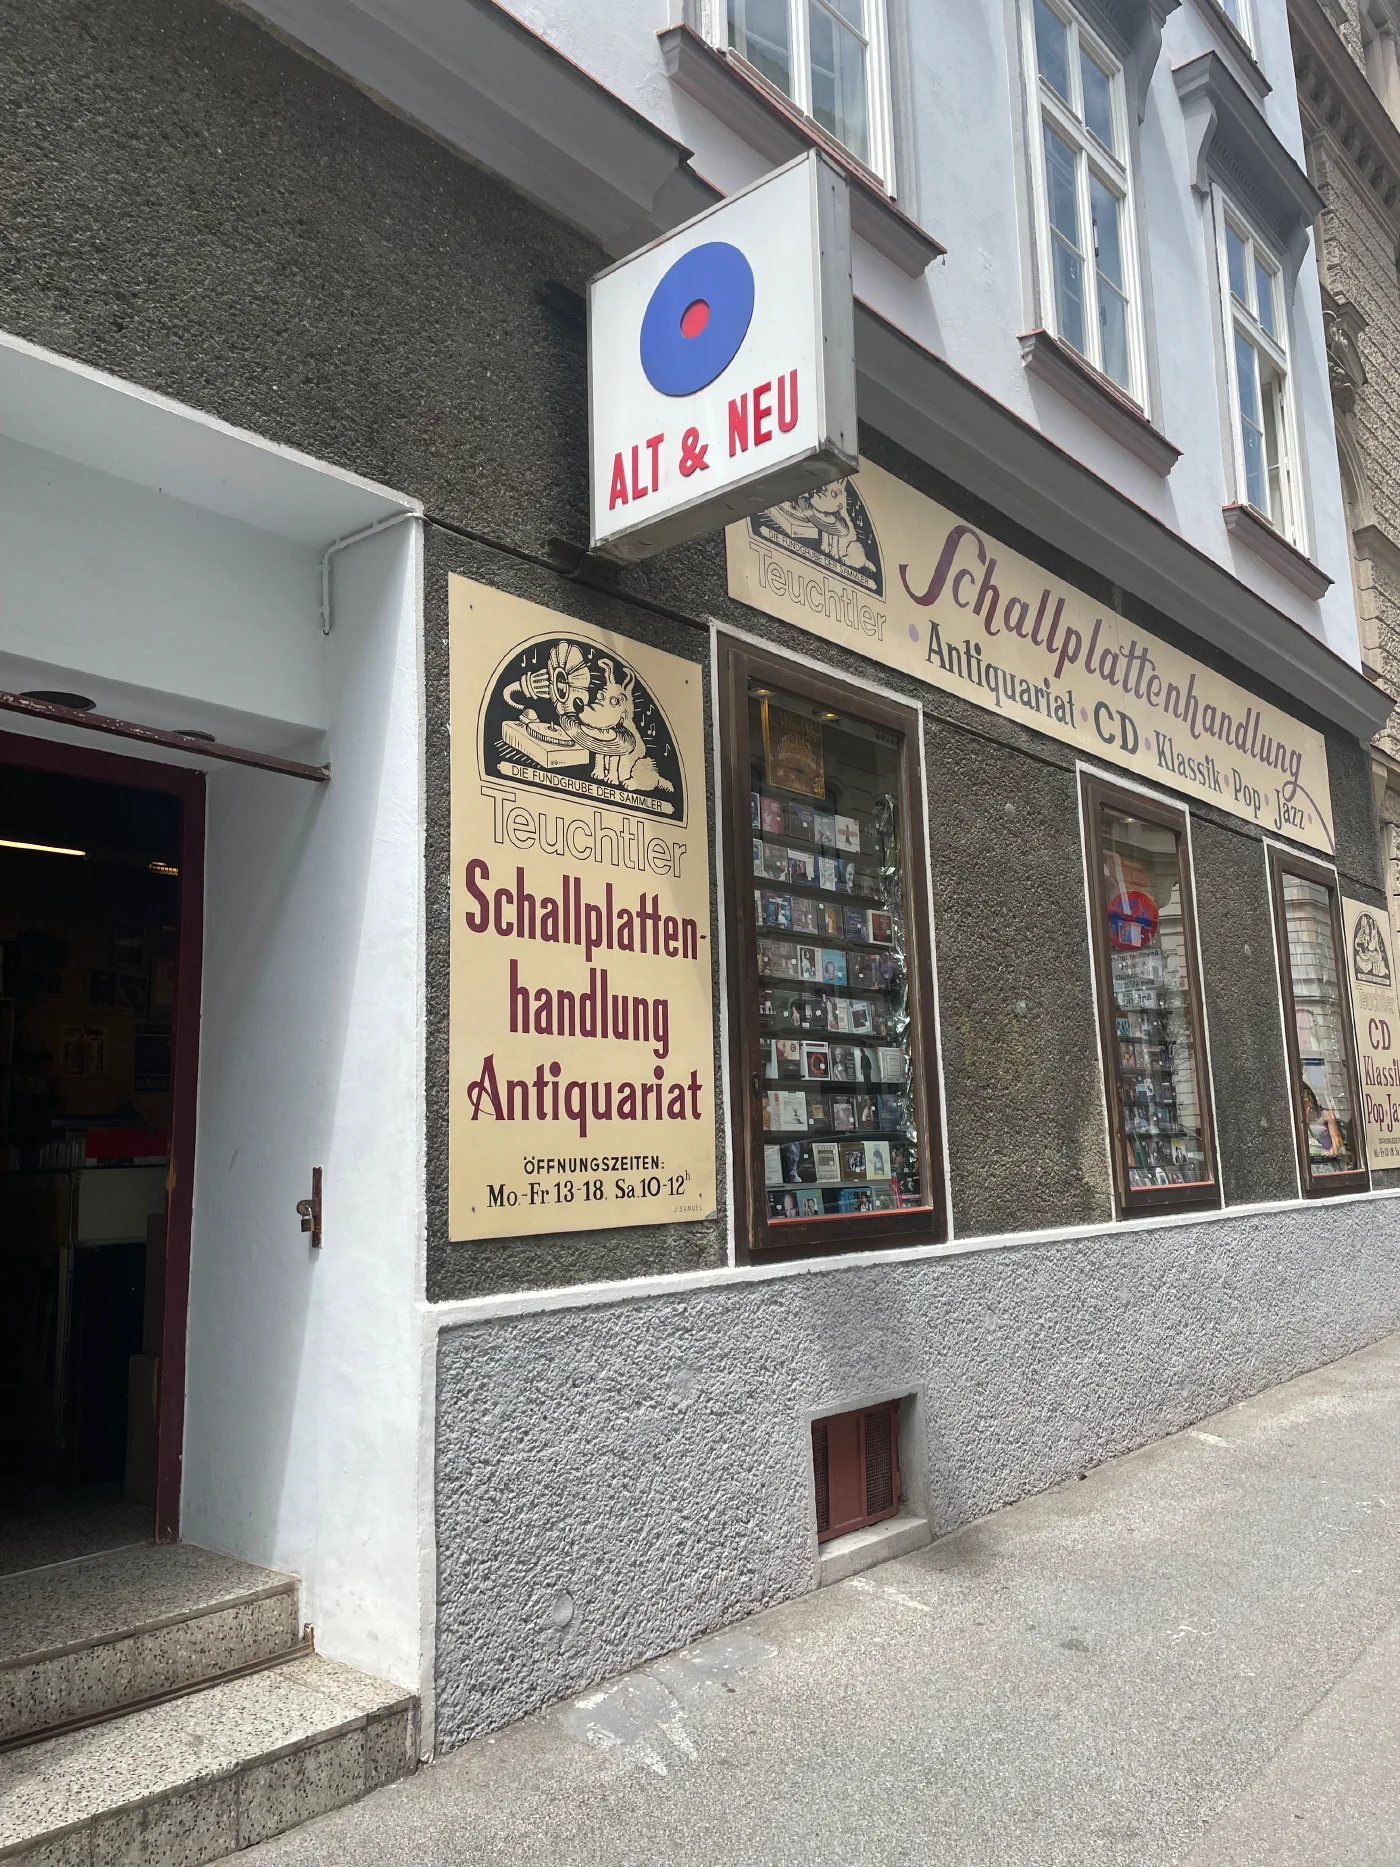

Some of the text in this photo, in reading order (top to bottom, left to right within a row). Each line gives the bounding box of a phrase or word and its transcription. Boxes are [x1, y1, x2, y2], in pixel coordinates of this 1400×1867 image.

[609, 368, 799, 510] ALT & NEU
[749, 541, 887, 642] Teuchtler
[768, 530, 869, 586] DIE FUNDGRUBE DER SAMMLER
[898, 524, 1334, 849] Schallplattenhandlung
[925, 619, 1305, 831] Antiquariat CD Klassik Pop Jazz
[480, 785, 687, 878] Teuchtler
[511, 765, 663, 812] DIE FUNDGRUBE DER SAMMLER
[465, 858, 708, 962] Schallplatten-
[509, 958, 669, 1060] handlung
[1369, 1018, 1391, 1051] CD
[467, 1053, 703, 1138] Antiquariat
[1365, 1094, 1384, 1132] Pop
[523, 1155, 666, 1176] ÖFFNUNGSZEITEN:
